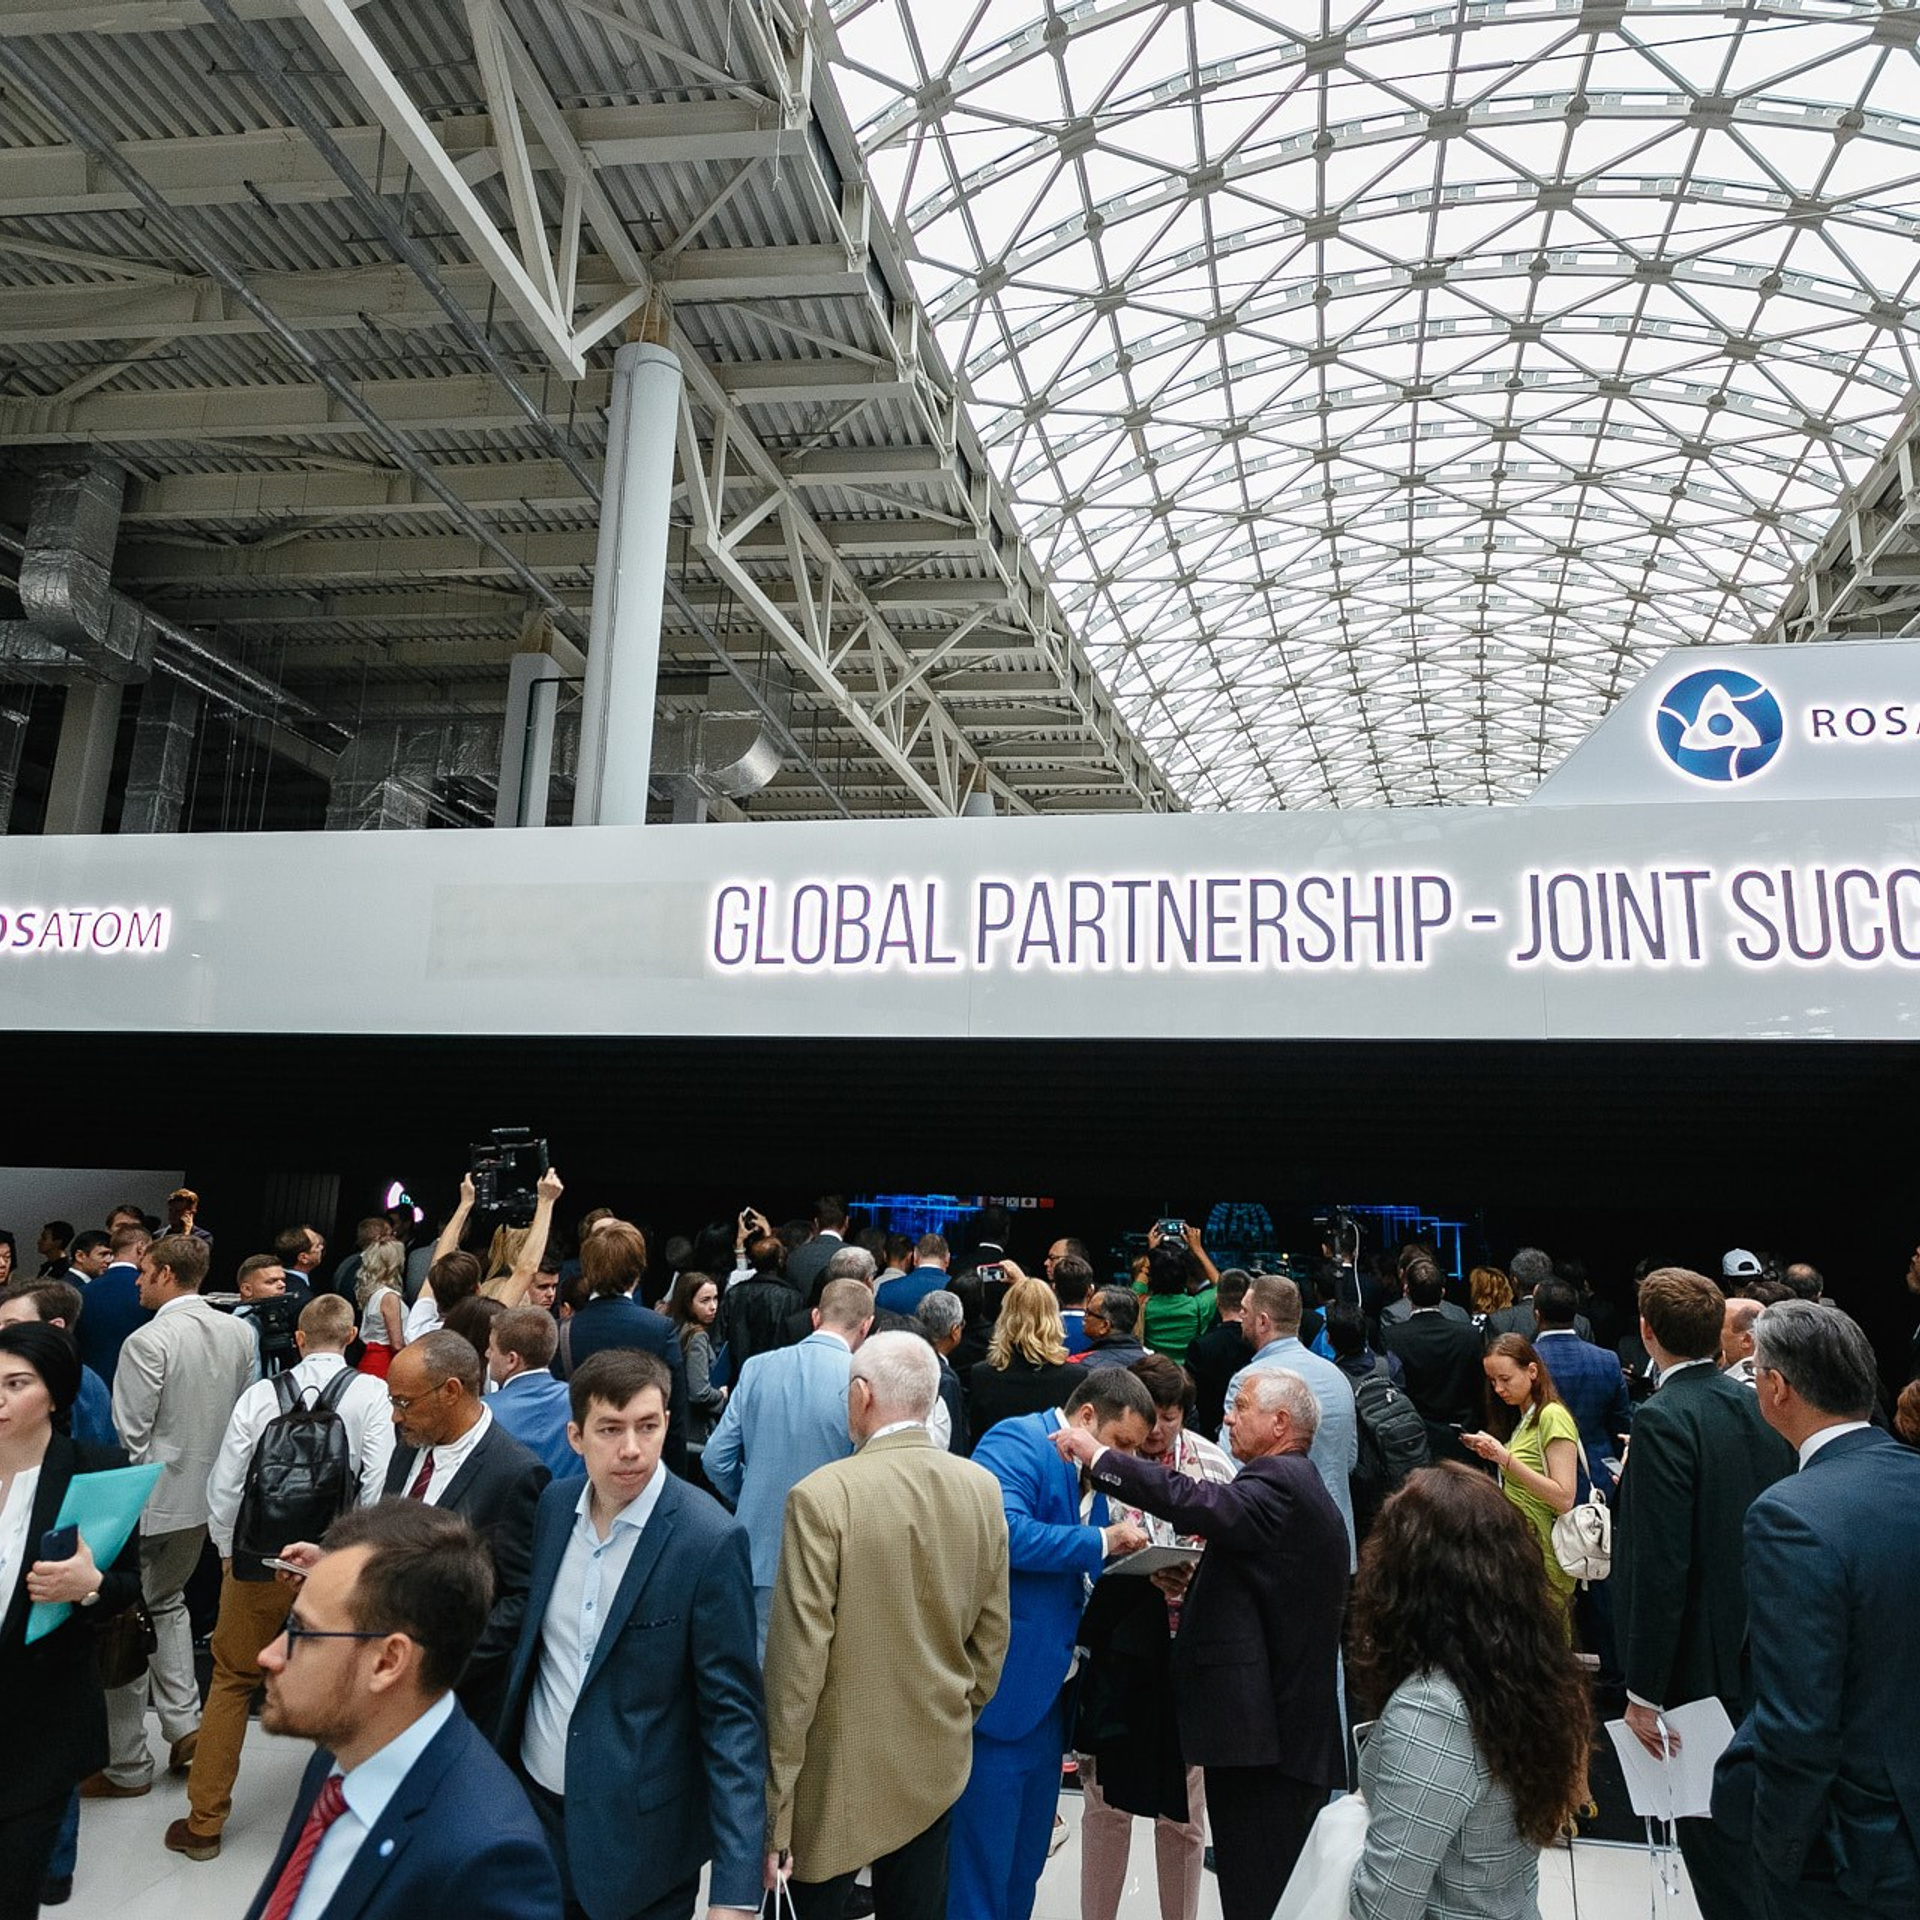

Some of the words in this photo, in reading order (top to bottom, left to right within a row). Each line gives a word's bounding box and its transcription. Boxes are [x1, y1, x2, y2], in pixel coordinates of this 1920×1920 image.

[1812, 706, 1920, 738] ROS
[0, 911, 163, 948] SATOM
[713, 882, 956, 966] GLOBAL
[977, 875, 1453, 965] PARTNERSHIP
[1517, 870, 1711, 963] JOINT
[1732, 868, 1920, 962] SUCC
